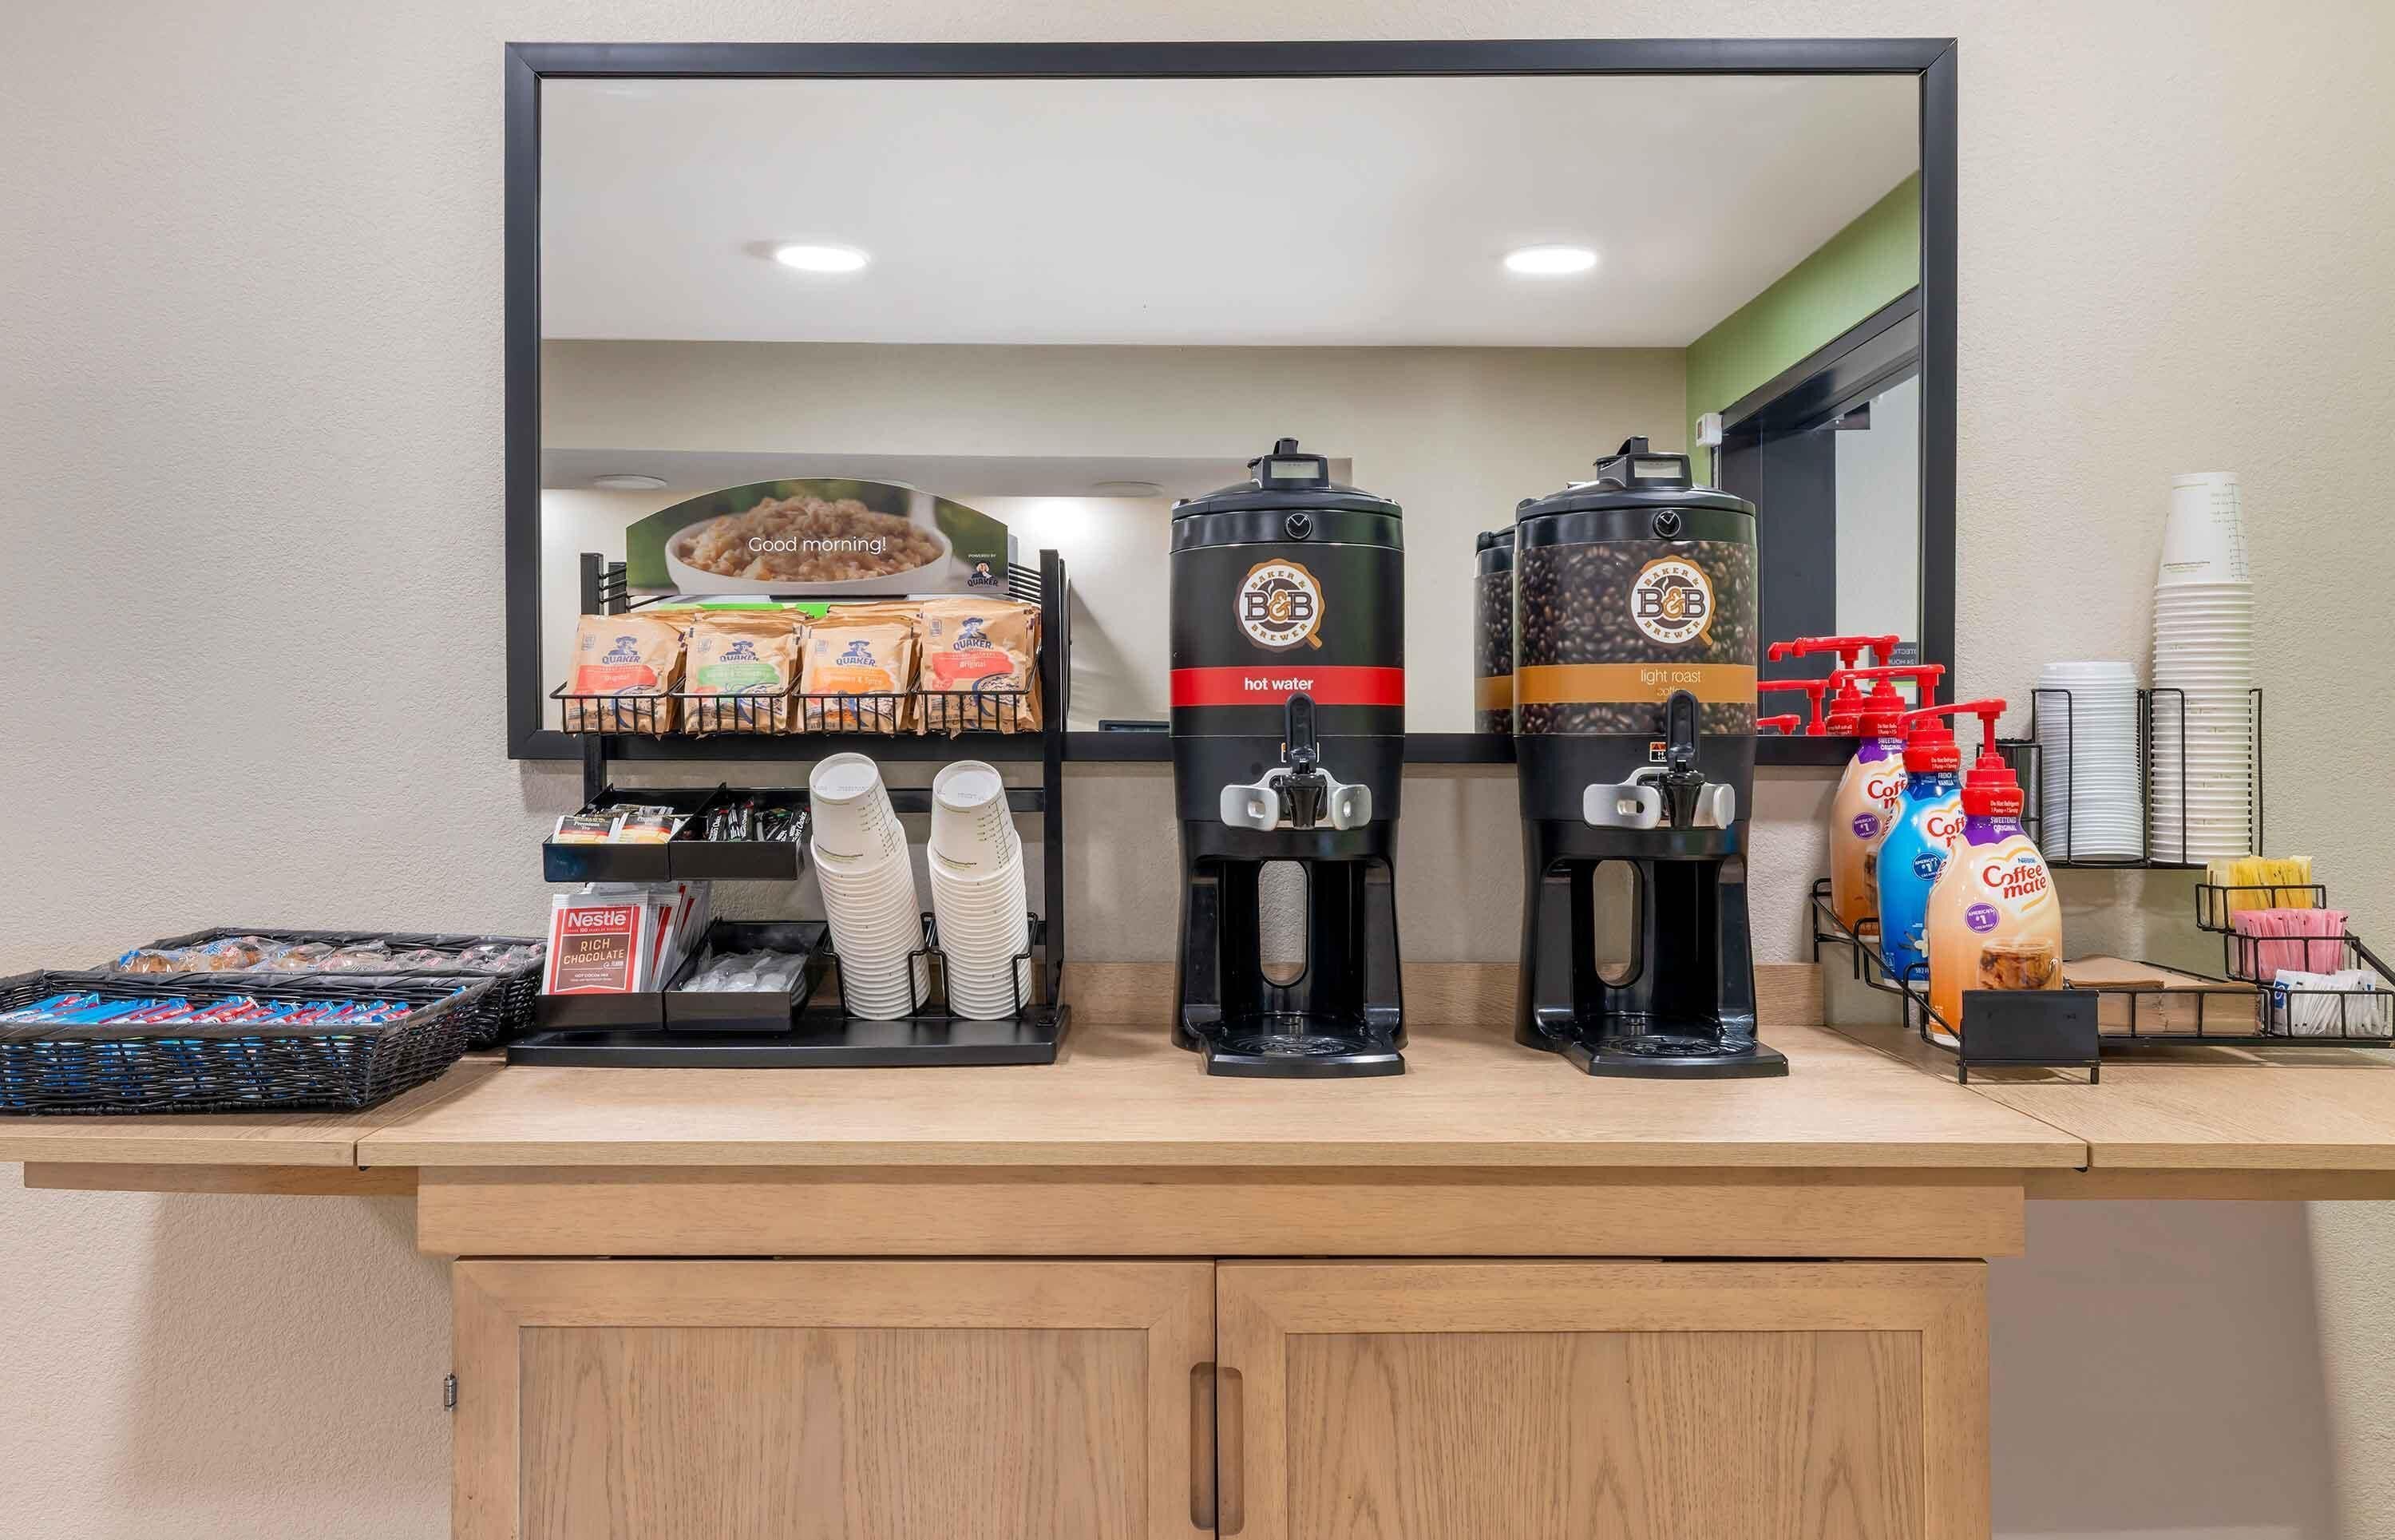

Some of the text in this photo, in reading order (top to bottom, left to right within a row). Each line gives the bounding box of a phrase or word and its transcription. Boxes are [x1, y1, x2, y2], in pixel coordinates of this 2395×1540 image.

[749, 536, 887, 555] Good morning!
[968, 578, 998, 588] QUAKER
[1251, 570, 1294, 590] BAKER
[1644, 567, 1689, 587] BAKER
[1245, 589, 1313, 624] B&B
[1637, 586, 1706, 622] B&B
[1251, 623, 1308, 642] BREWER
[1644, 620, 1700, 639] BREWER
[953, 639, 992, 651] QUAKER
[602, 655, 640, 665] QUAKER
[836, 657, 876, 667] QUAKER
[1245, 678, 1314, 691] hot water
[1641, 669, 1700, 685] light roast
[1868, 779, 1906, 799] Coff
[1926, 817, 1965, 837] Coff
[1982, 864, 2044, 888] Coffee
[2003, 876, 2046, 899] mate
[580, 938, 611, 952] RICH
[563, 949, 625, 965] CHOCOLATE
